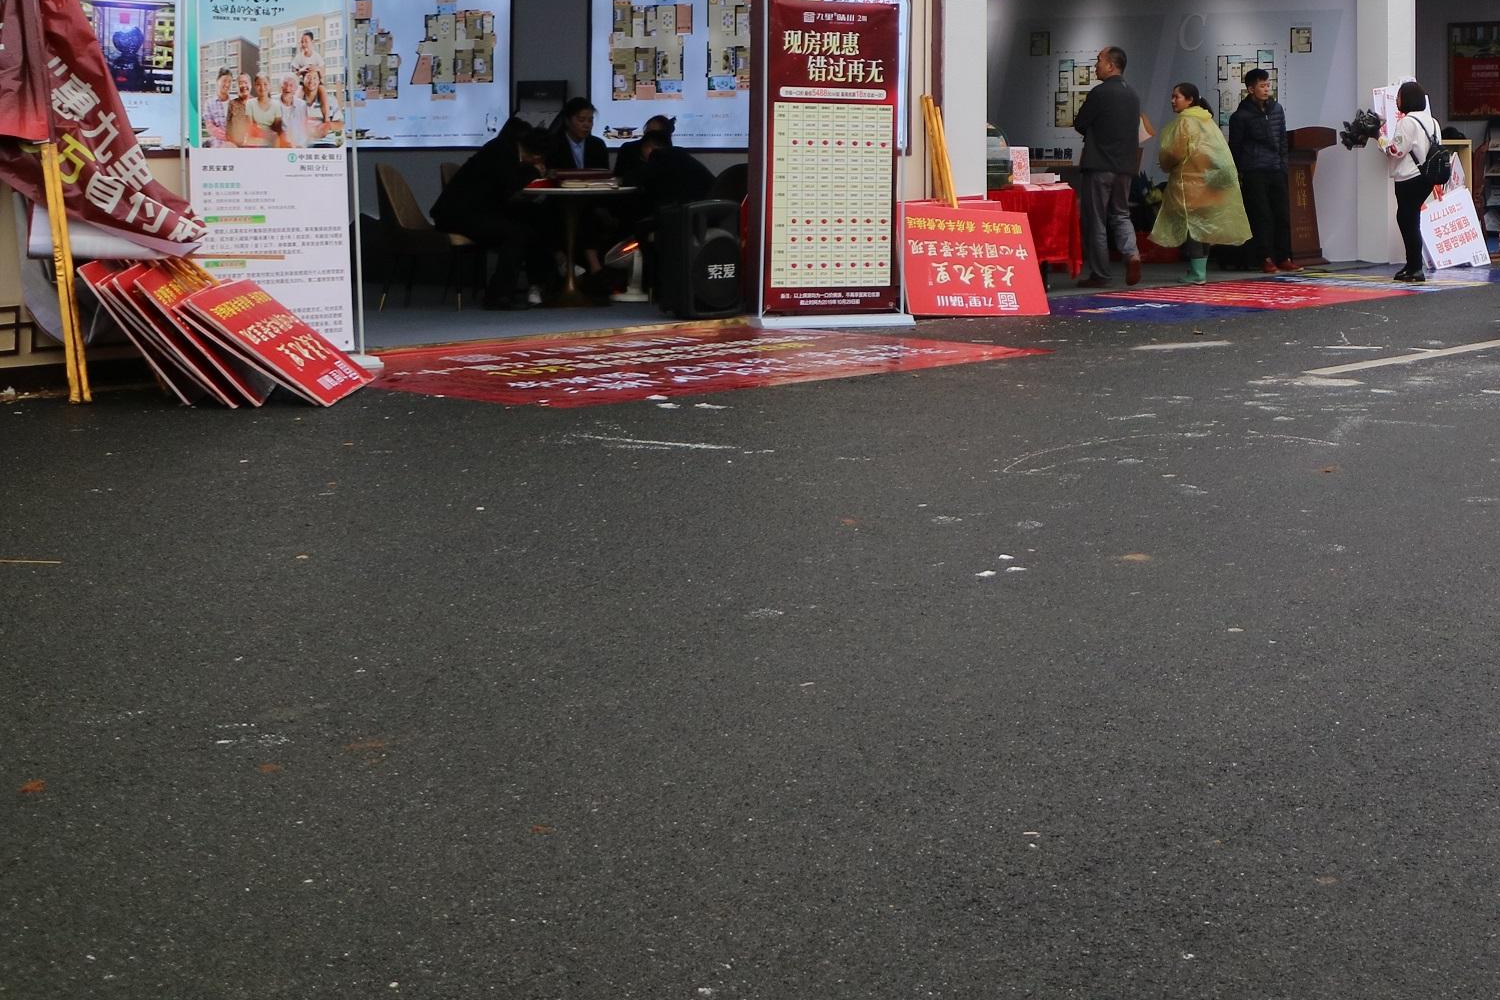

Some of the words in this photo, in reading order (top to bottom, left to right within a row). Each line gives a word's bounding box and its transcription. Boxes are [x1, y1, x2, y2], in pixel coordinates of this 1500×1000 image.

[783, 30, 860, 56] 现房现惠
[807, 57, 884, 84] 错过再无
[707, 263, 736, 280] 索爱
